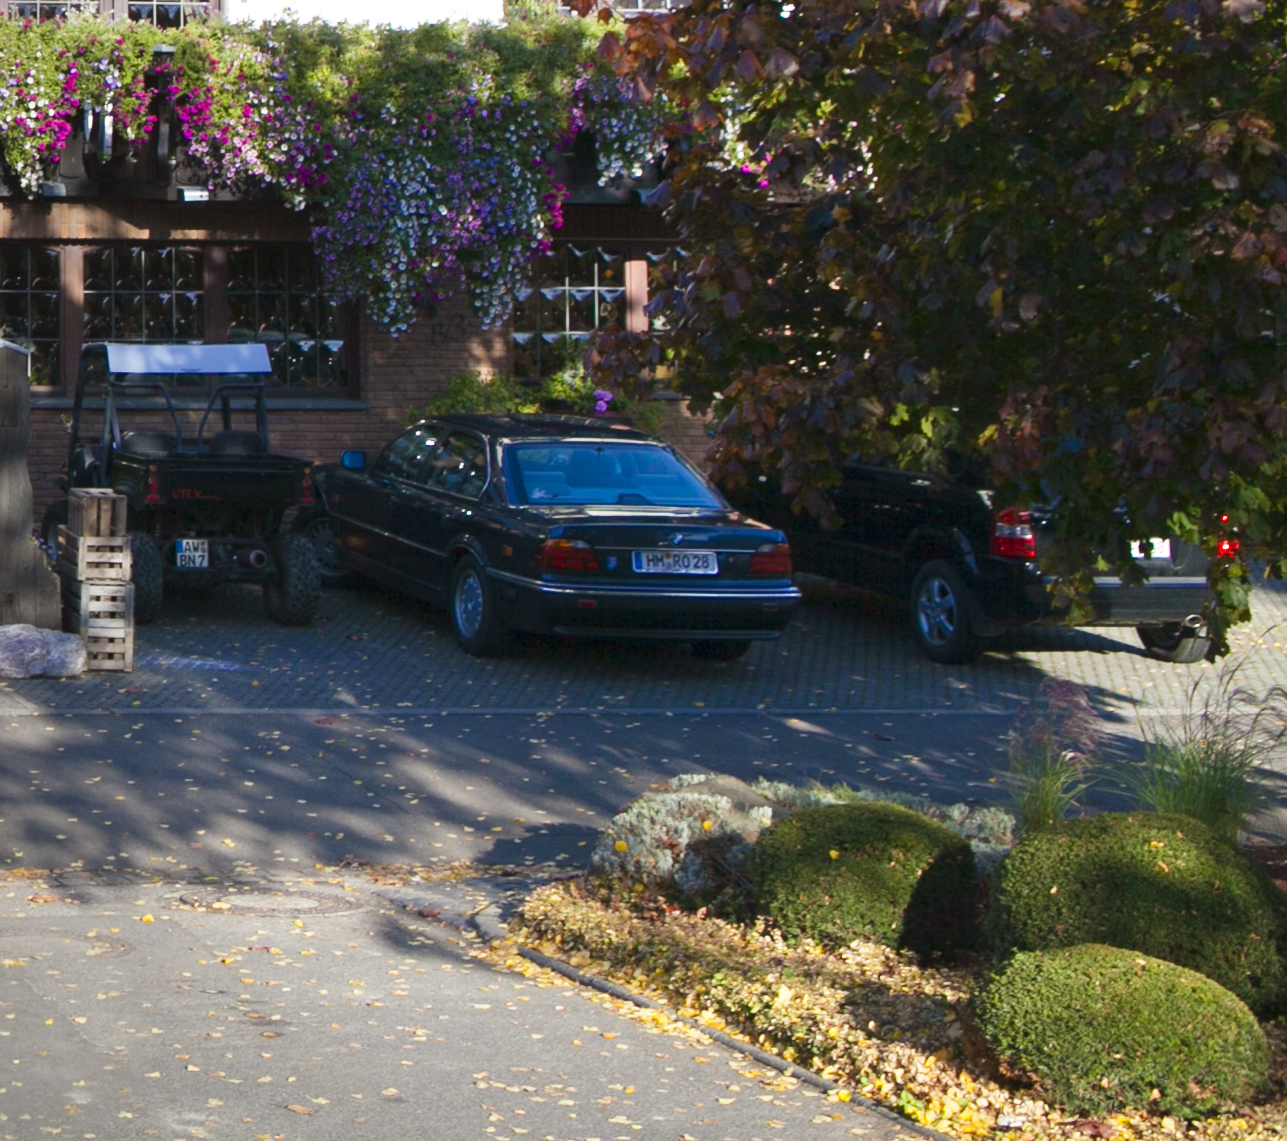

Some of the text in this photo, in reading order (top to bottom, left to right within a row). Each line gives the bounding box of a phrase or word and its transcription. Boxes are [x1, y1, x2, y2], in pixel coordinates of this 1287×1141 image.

[184, 540, 199, 553] AW
[646, 554, 665, 568] HM
[693, 556, 710, 569] 28
